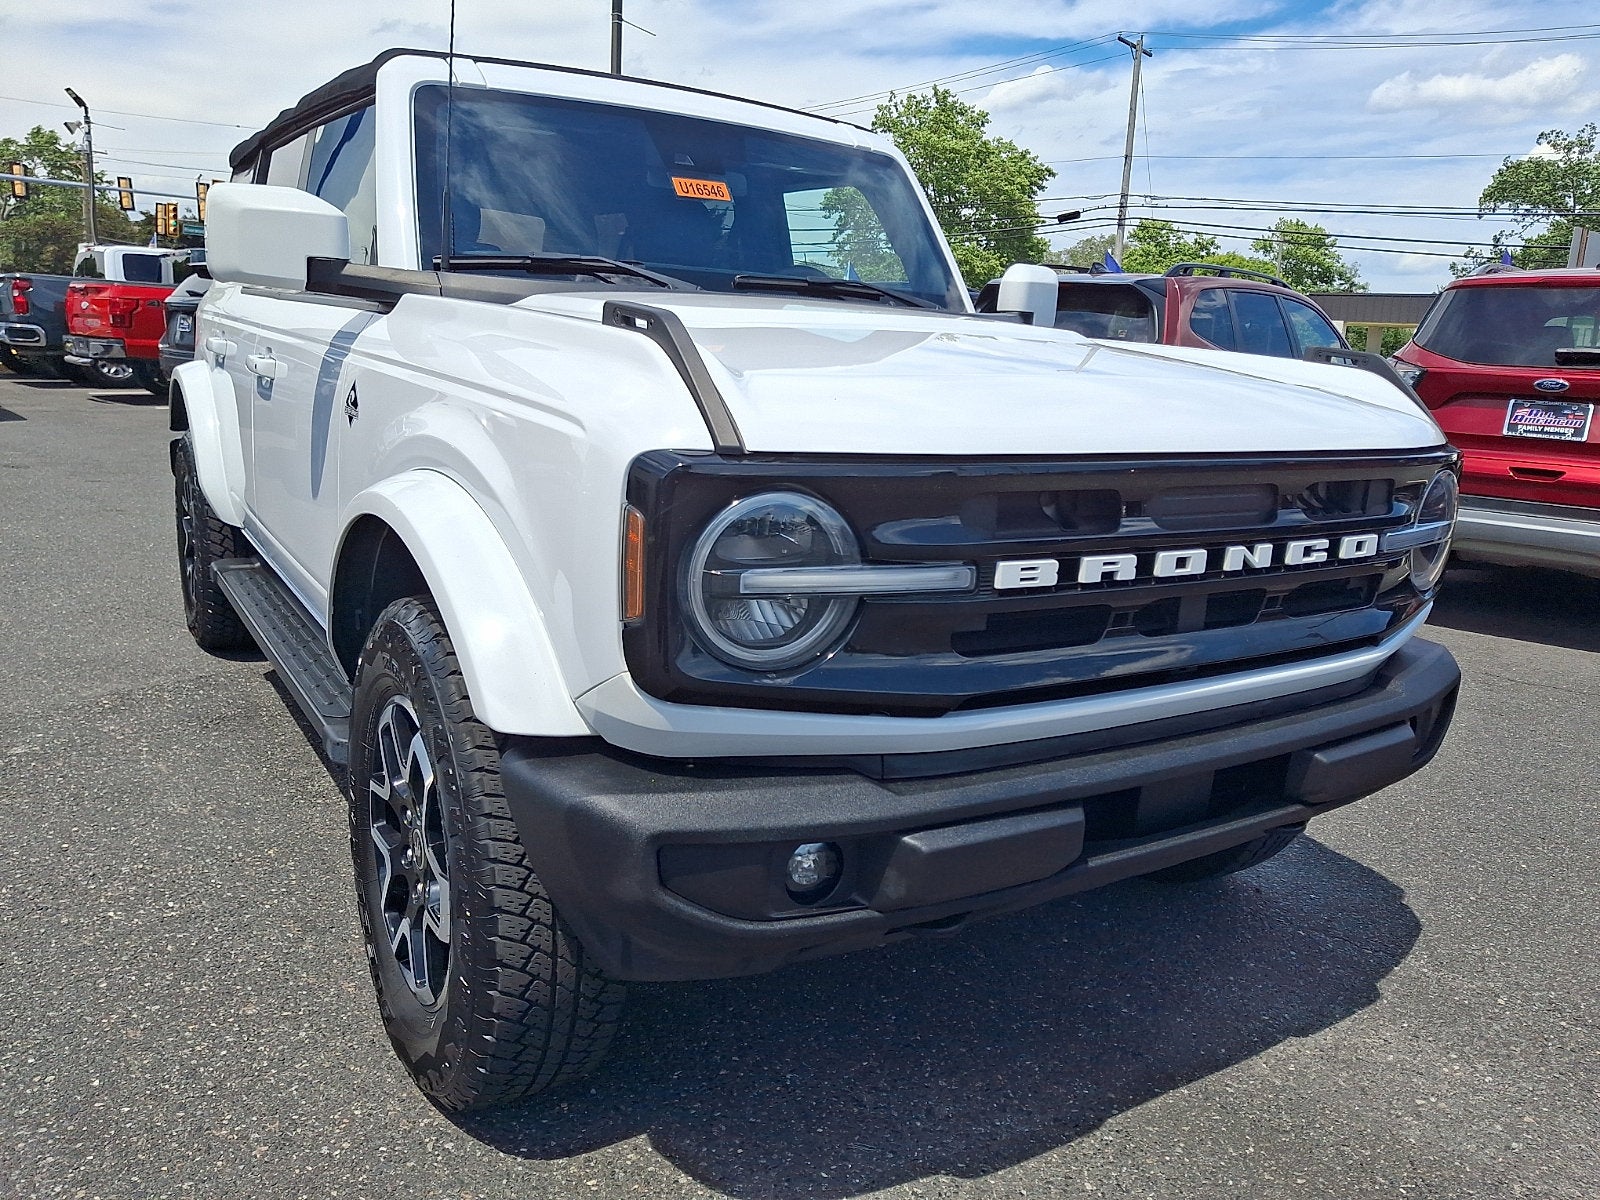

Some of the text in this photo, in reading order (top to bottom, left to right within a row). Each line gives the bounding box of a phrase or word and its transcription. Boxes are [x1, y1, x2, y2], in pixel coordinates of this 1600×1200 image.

[678, 181, 725, 198] U16546
[1541, 381, 1562, 390] Ford
[1517, 424, 1575, 434] FAMILY MEMBER
[993, 533, 1379, 590] BRONCO
